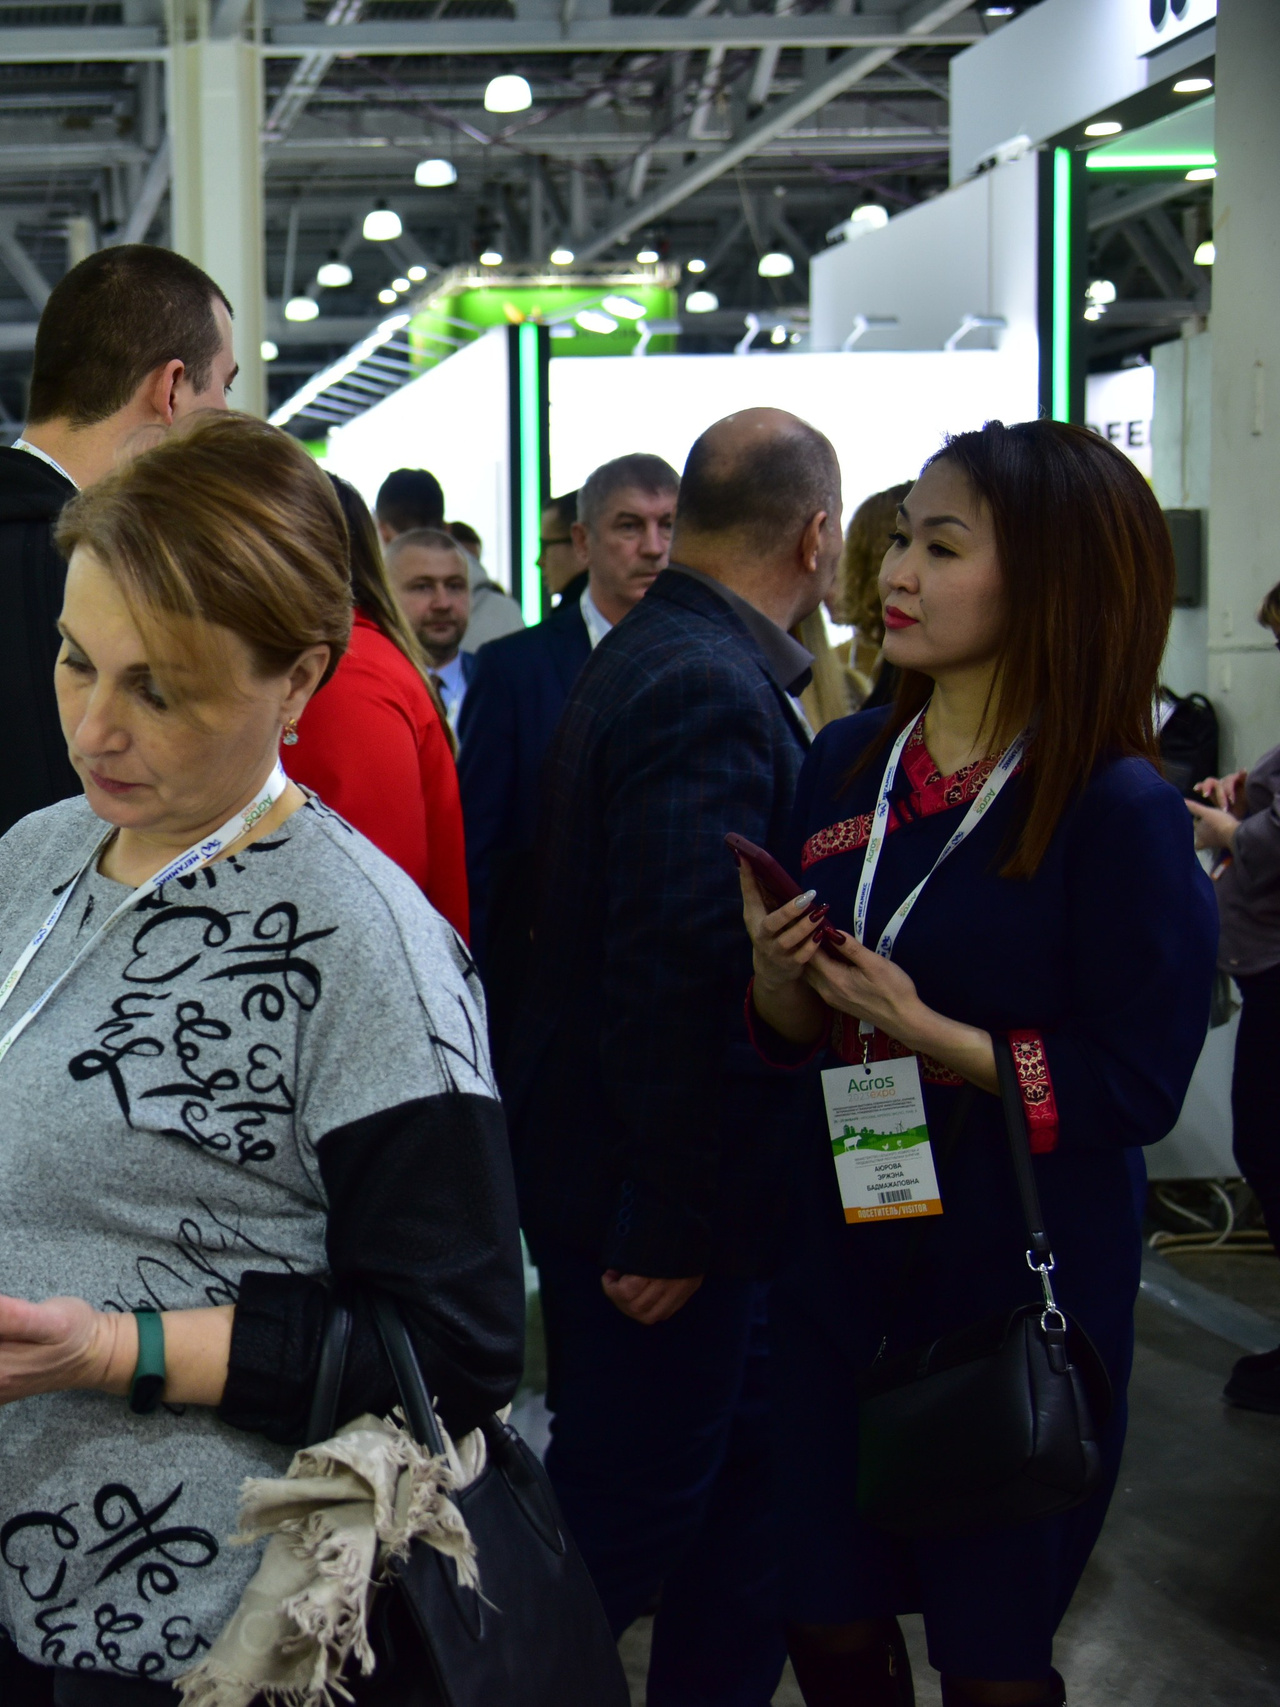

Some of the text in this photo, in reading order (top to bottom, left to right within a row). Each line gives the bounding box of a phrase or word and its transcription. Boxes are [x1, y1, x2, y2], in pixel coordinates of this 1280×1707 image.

[155, 853, 200, 887] МЕГАМИКС
[848, 1076, 895, 1093] Agros
[870, 1089, 896, 1099] expo
[874, 1163, 902, 1172] АЮРОВА
[877, 1171, 905, 1180] ЭРЖЭНА
